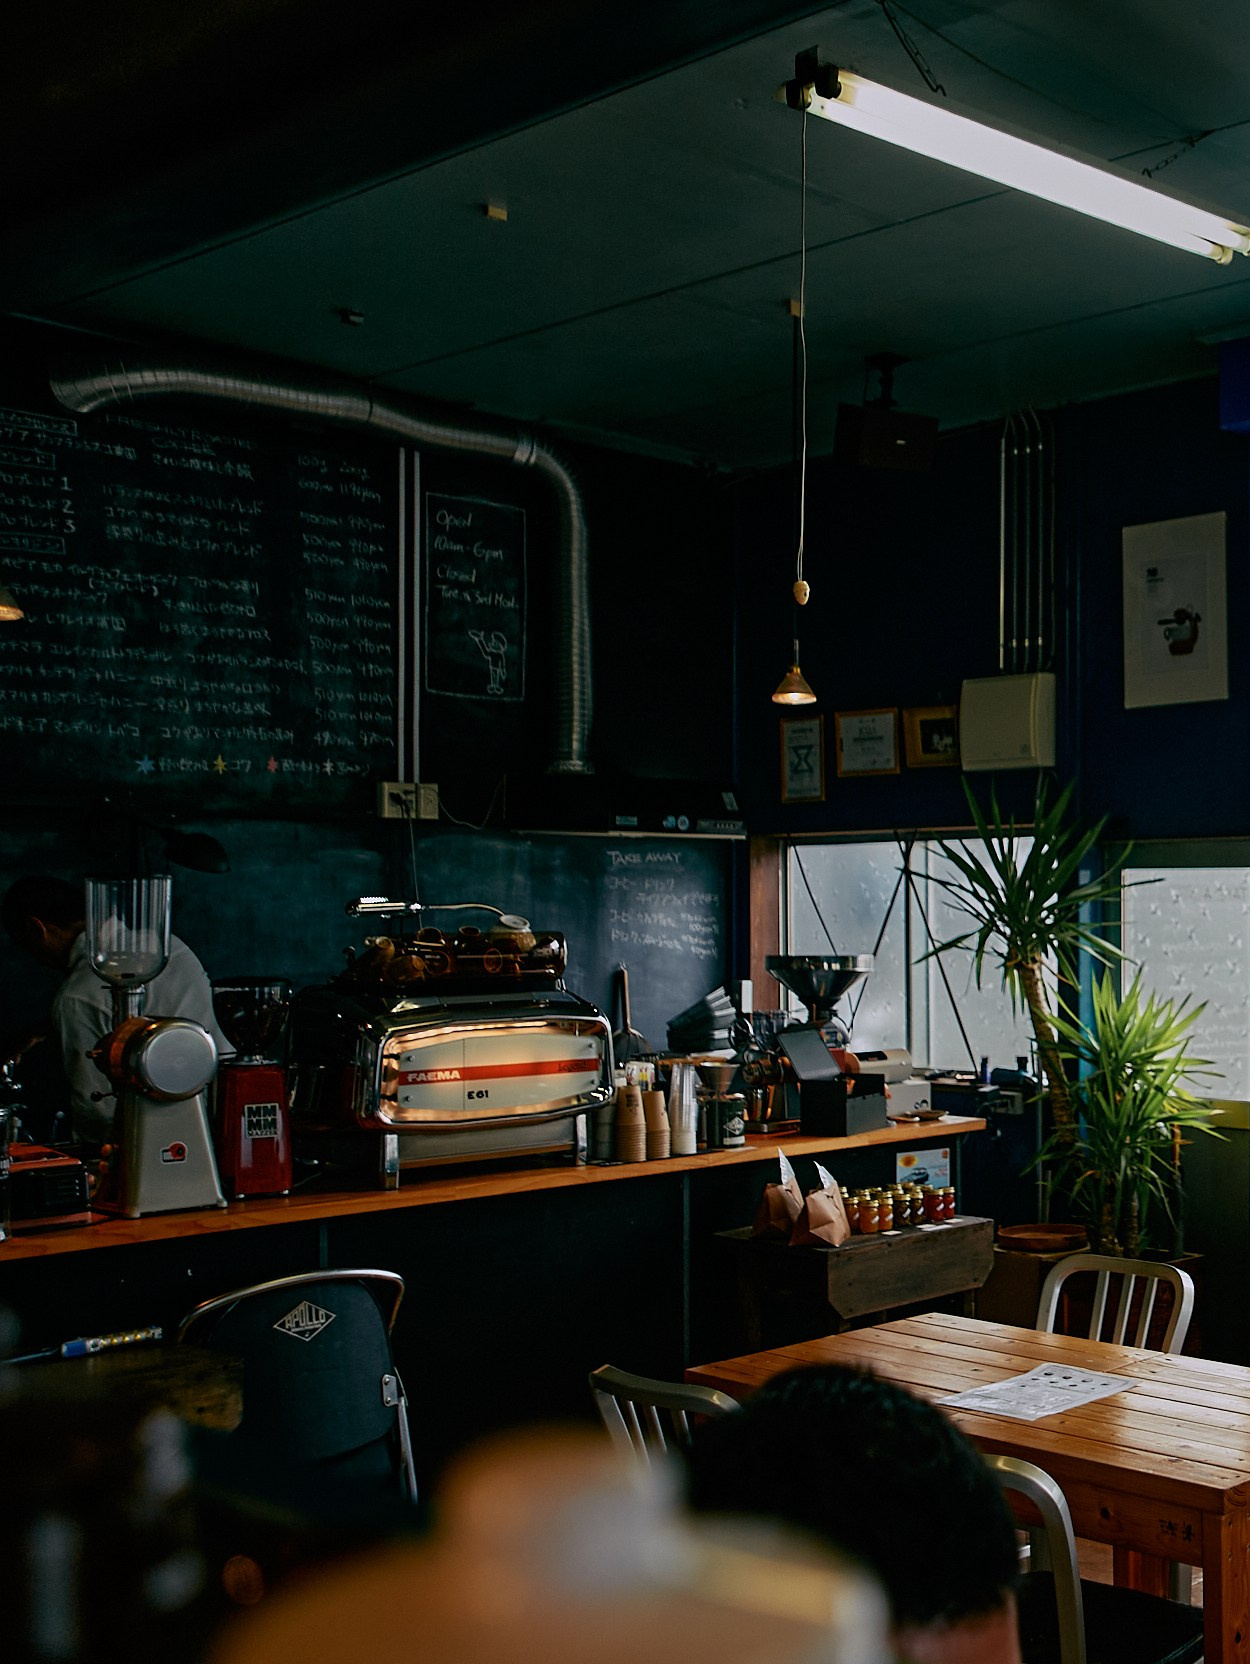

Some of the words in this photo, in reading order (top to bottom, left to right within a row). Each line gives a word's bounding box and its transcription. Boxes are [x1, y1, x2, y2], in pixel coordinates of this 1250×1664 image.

[437, 563, 476, 584] Closed
[606, 850, 641, 865] TAKE
[645, 851, 682, 864] AWAY
[407, 1069, 462, 1083] FAEMA
[285, 1303, 326, 1330] APOLLO
